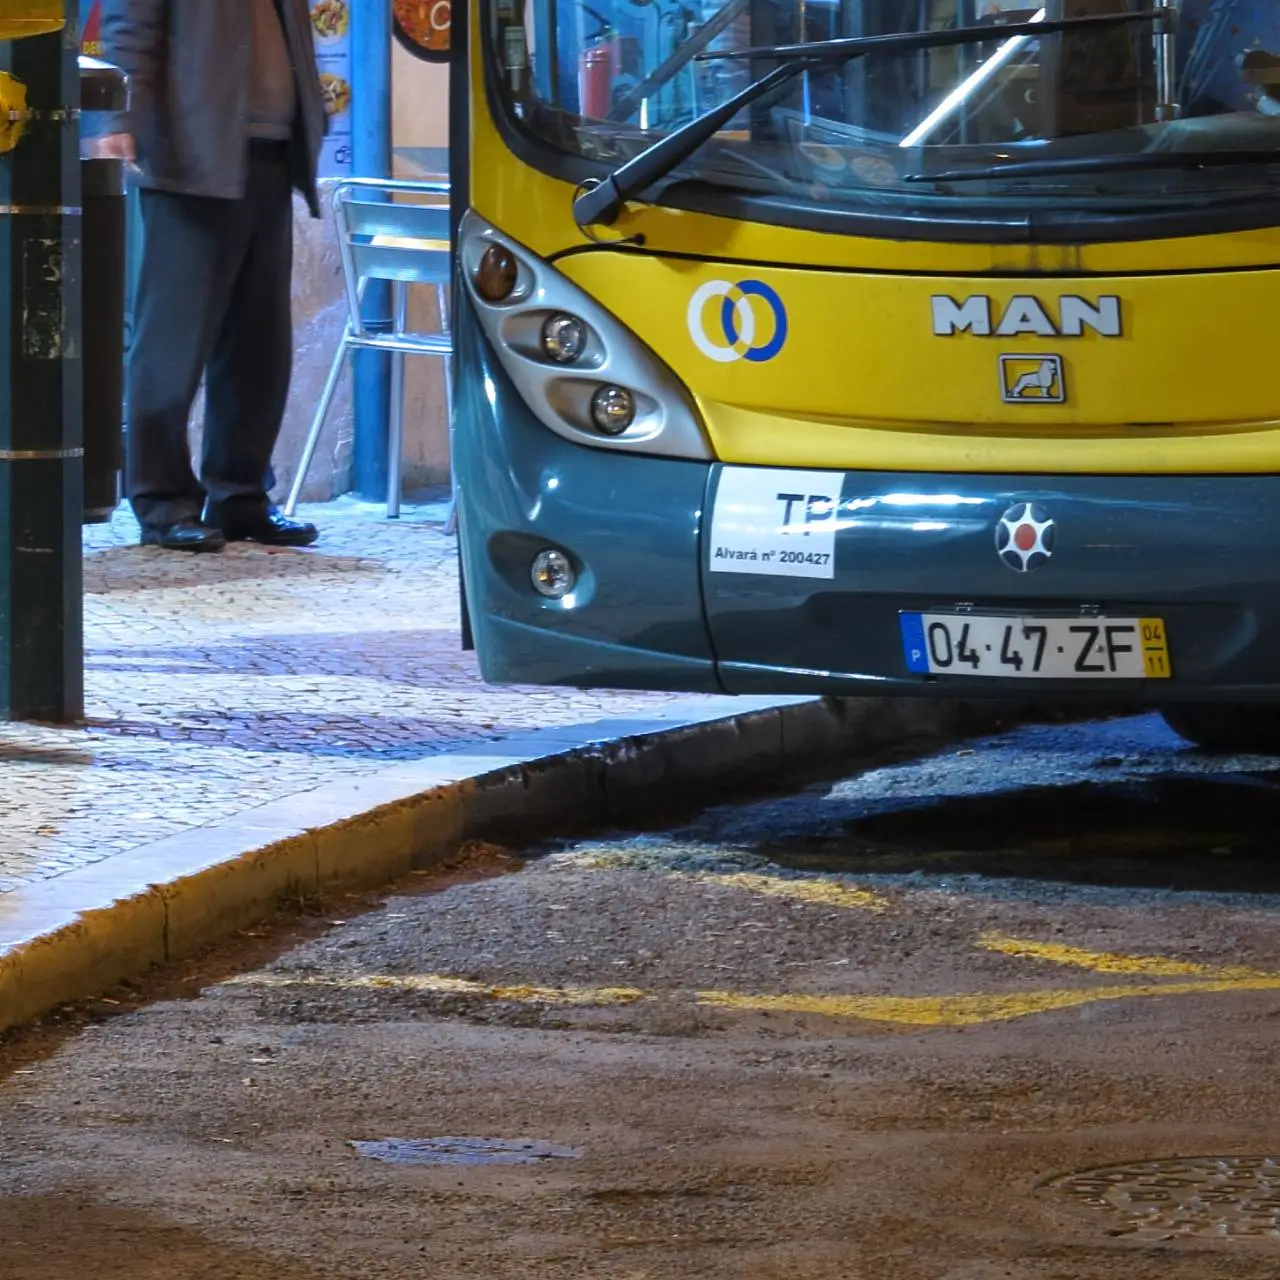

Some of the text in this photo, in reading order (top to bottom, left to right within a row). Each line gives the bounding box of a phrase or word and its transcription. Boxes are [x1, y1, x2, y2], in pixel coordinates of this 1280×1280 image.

[930, 294, 1122, 339] MAN
[775, 492, 833, 536] TP
[714, 545, 758, 564] Alvará
[779, 549, 831, 566] 200427
[1143, 624, 1162, 644] 04
[1147, 654, 1166, 674] 11
